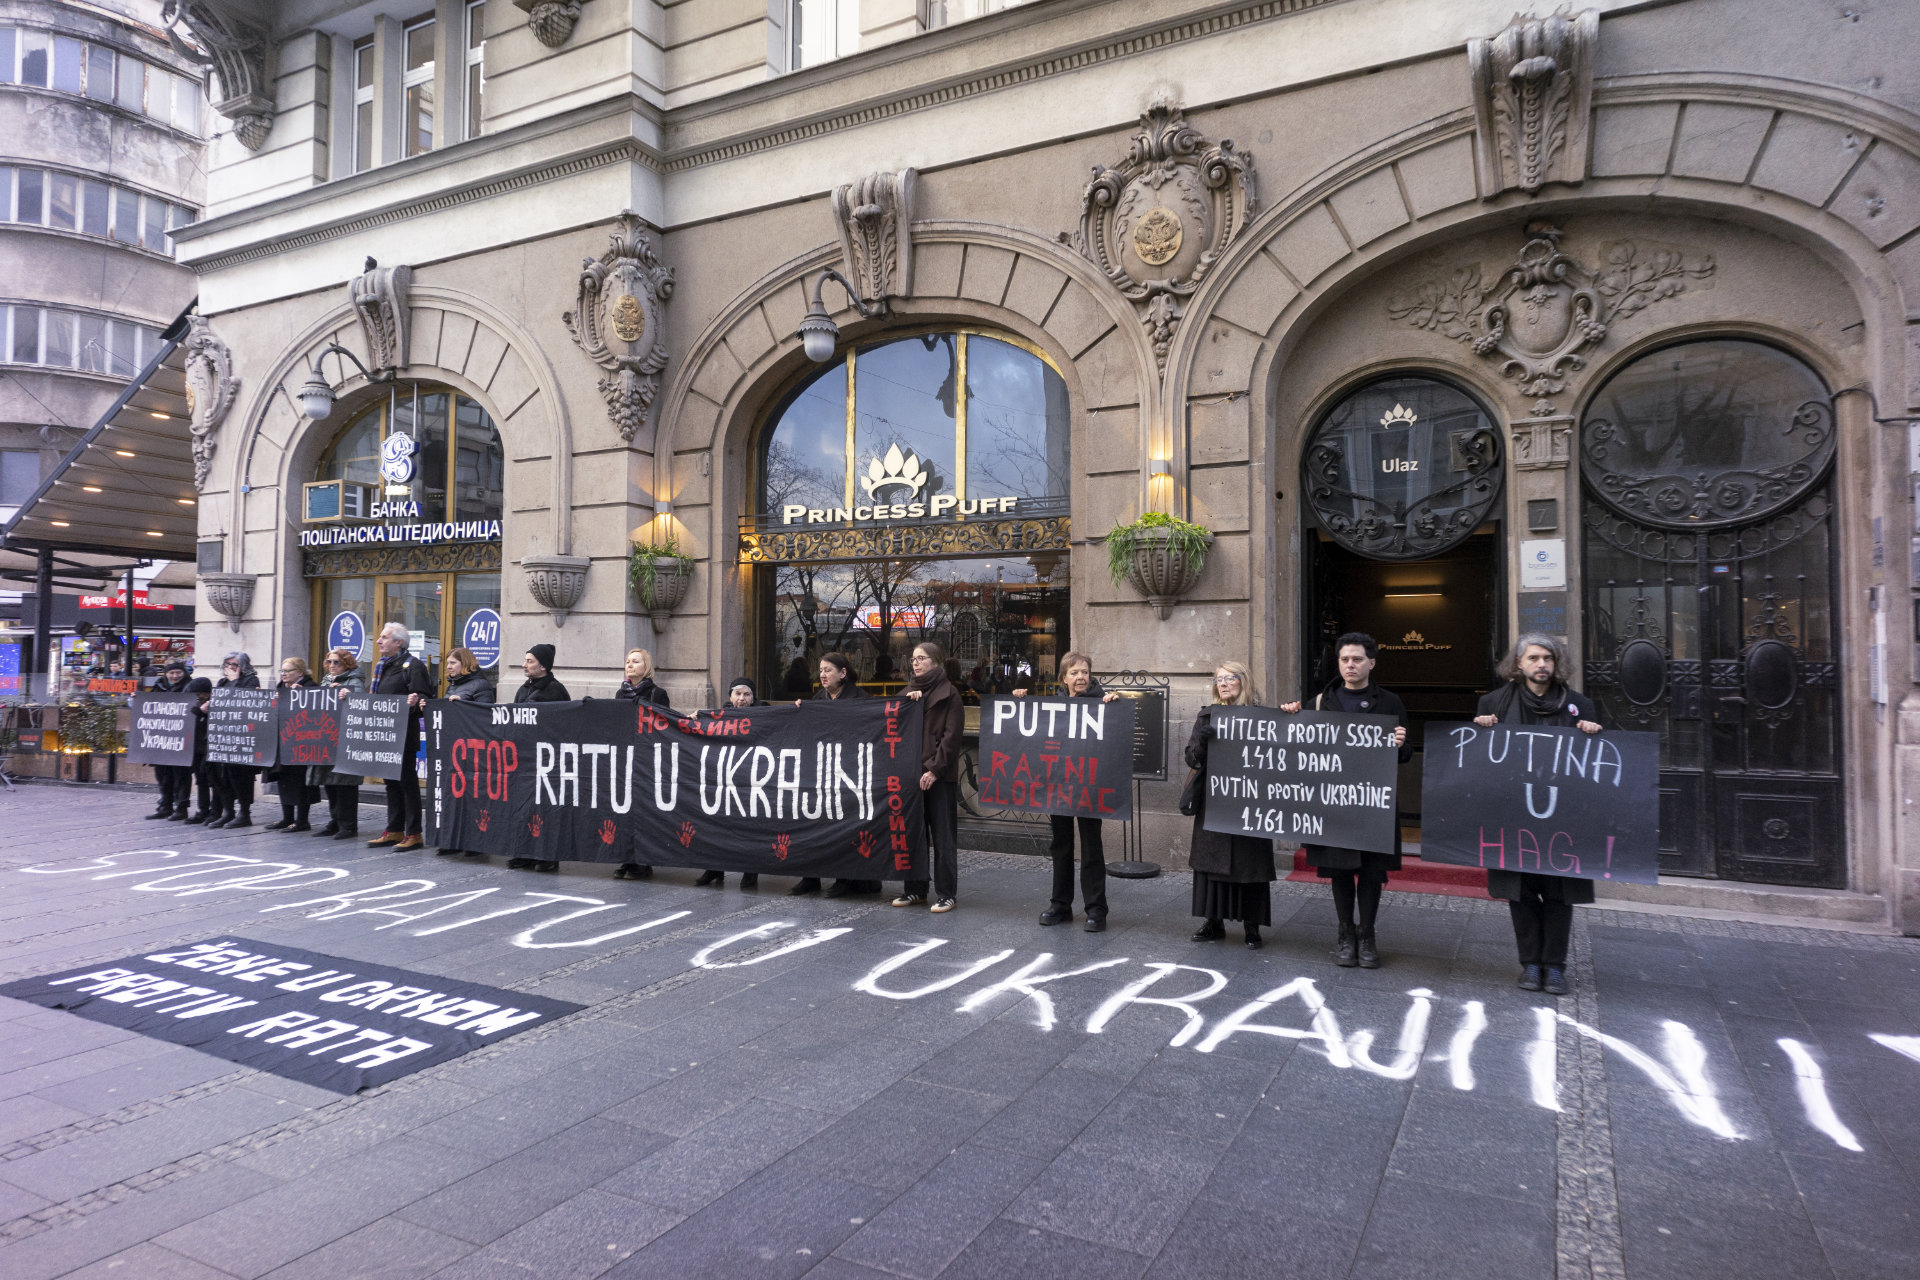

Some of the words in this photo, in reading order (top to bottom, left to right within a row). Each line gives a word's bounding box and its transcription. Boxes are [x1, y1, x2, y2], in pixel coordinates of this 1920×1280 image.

[1382, 458, 1418, 473] Ulaz
[370, 501, 419, 518] БАНКА
[783, 503, 925, 525] PRINCESS
[930, 495, 1018, 517] PUFF
[1536, 508, 1549, 524] 7
[301, 526, 385, 546] ПОШТАНСКА
[388, 519, 501, 544] ШТЕДИОНИЦА
[471, 621, 498, 645] 24/7
[142, 701, 189, 716] ОСТАНОВИТЕ
[290, 689, 338, 711] PUTIN
[372, 699, 400, 714] GUBICI
[209, 711, 227, 721] STOP
[229, 711, 243, 720] THE
[247, 711, 270, 722] RAPE
[492, 706, 510, 725] NO
[512, 707, 538, 725] WAR
[637, 705, 669, 735] Не
[993, 700, 1105, 740] PUTIN
[1216, 716, 1278, 743] HITLER
[1287, 722, 1340, 745] PROTIV
[991, 751, 1099, 785] RATNI
[1298, 751, 1342, 773] DANA
[1450, 727, 1622, 787] PUTINA
[451, 738, 519, 802] STOP
[535, 741, 635, 814] RATU
[653, 742, 679, 812] U
[700, 741, 874, 821] UKRAJINI
[979, 772, 1116, 814] ZLOČINAC
[1210, 775, 1258, 799] PUTIN
[1320, 781, 1392, 809] UKRAJINE
[1523, 782, 1558, 819] U
[1293, 812, 1324, 836] DAN
[18, 850, 351, 897] STOP
[258, 879, 694, 950] RATU
[690, 921, 854, 970] U
[144, 941, 312, 983] ŽENE
[274, 969, 356, 993] U
[318, 980, 542, 1036] CRNOM
[47, 967, 259, 1019] PROTIV
[226, 1010, 434, 1069] RATA
